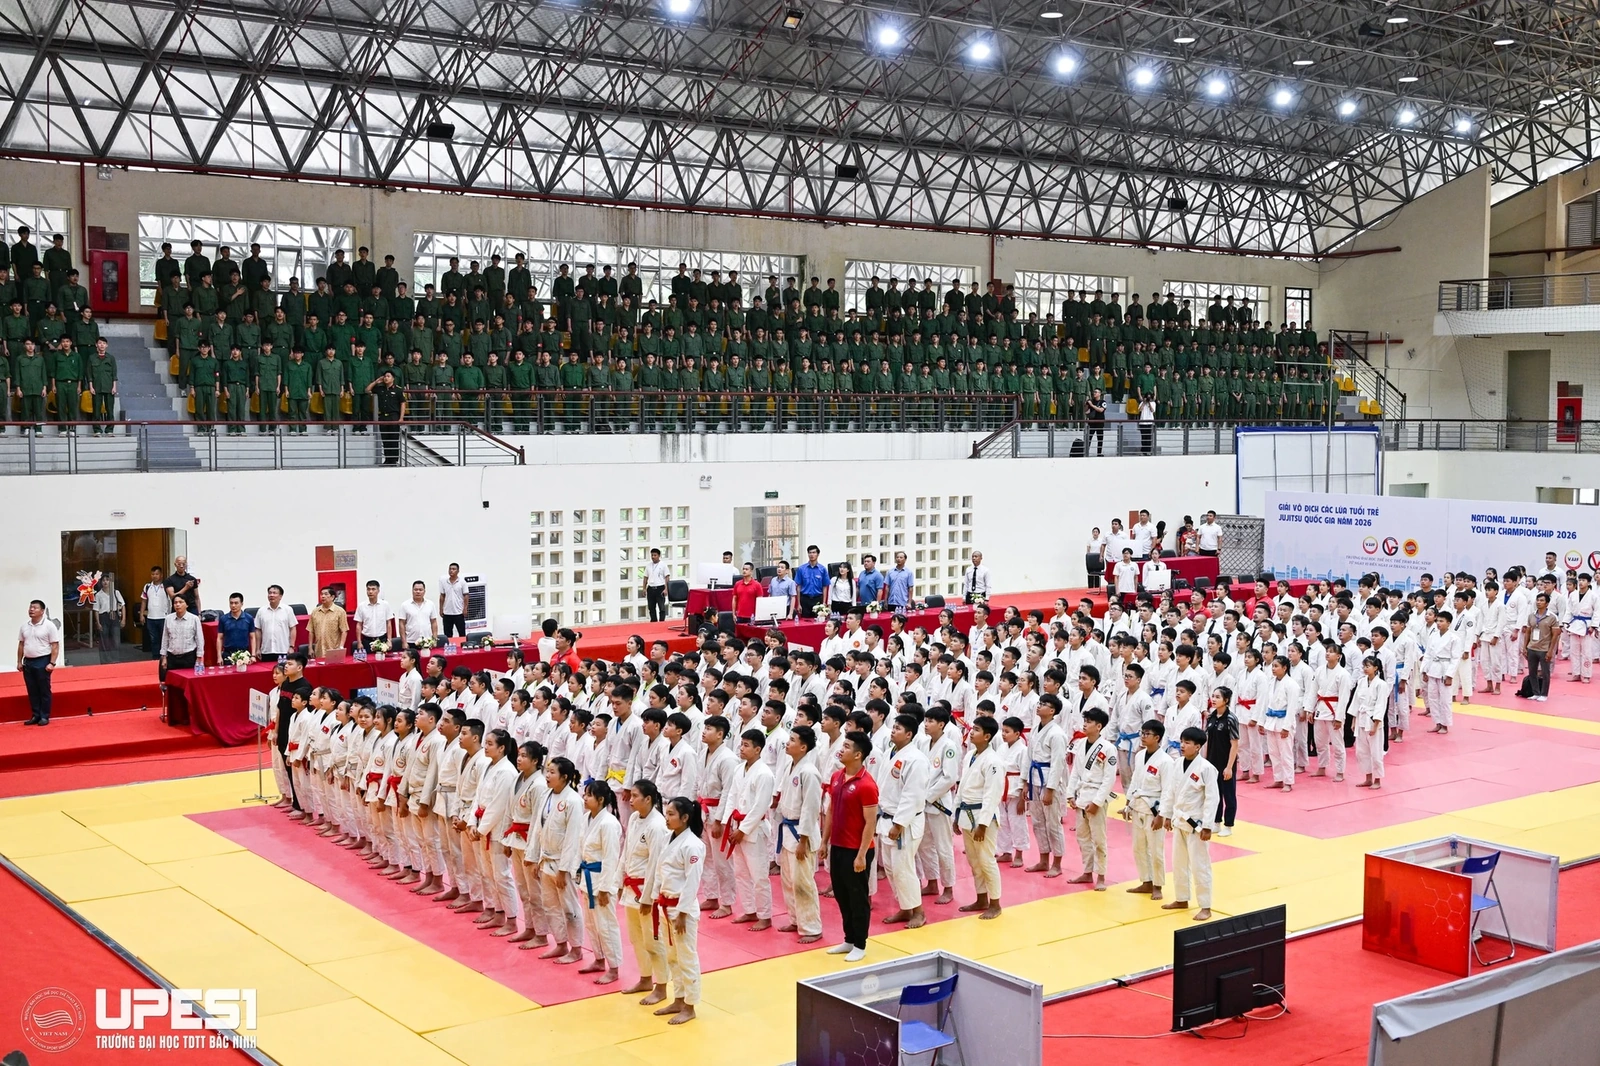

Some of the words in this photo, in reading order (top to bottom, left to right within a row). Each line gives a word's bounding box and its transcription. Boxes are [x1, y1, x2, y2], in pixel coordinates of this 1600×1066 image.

[1279, 514, 1302, 522] JUJITSU
[1304, 514, 1322, 524] QUỐC
[1471, 514, 1506, 524] NATIONAL
[1509, 516, 1538, 525] JUJITSU
[1471, 526, 1495, 535] YOUTH
[1498, 527, 1554, 538] CHAMPIONSHIP
[1556, 530, 1577, 539] 2026
